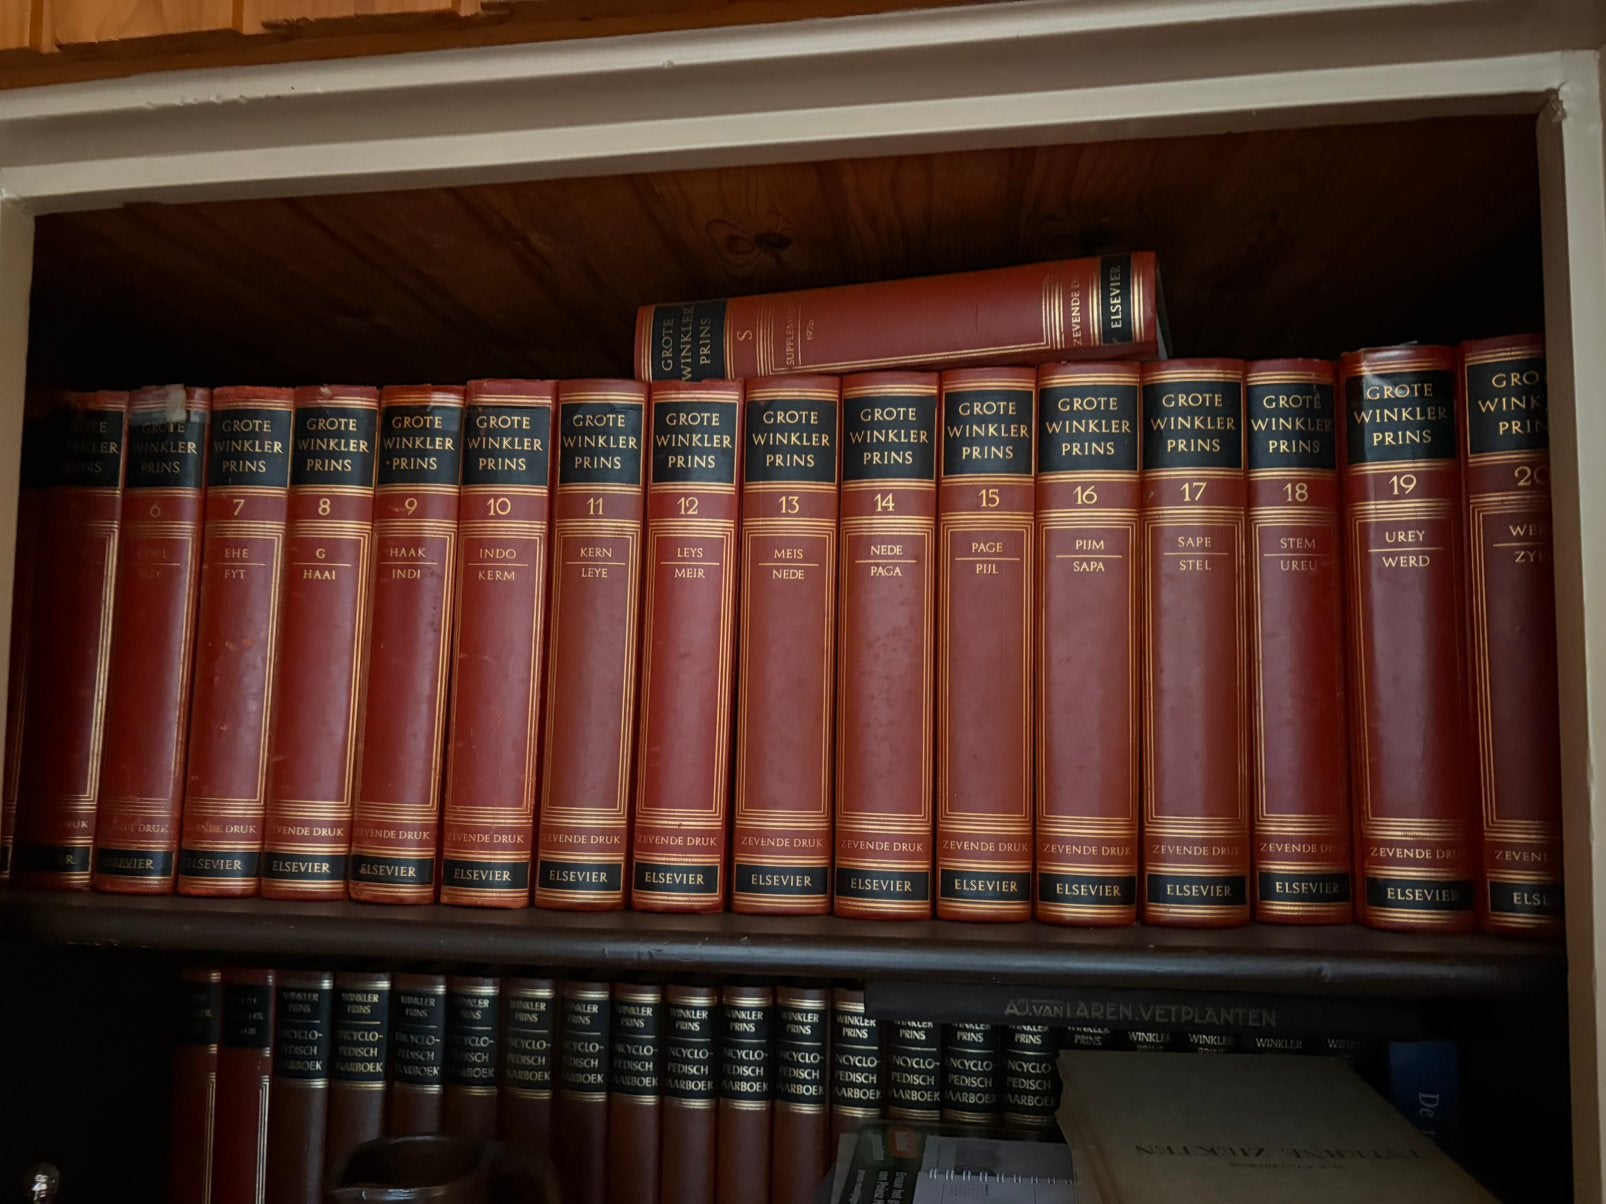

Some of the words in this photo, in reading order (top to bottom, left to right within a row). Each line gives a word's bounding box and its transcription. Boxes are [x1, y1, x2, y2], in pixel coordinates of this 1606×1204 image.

[1109, 265, 1122, 329] ELSEVIER
[1071, 290, 1082, 346] ZEVENDE
[680, 304, 694, 381] WINKLER
[699, 318, 711, 365] PRINS
[737, 330, 752, 342] S
[661, 318, 674, 372] GROTE
[1367, 383, 1433, 400] GROTE
[1058, 397, 1118, 412] GROTE
[1162, 393, 1223, 408] GROTE
[1263, 395, 1321, 410] GROTE
[860, 408, 917, 422] GROTE
[958, 402, 1017, 416] GROTE
[1353, 405, 1447, 424] WINKLER
[306, 418, 358, 431] GROTE
[391, 416, 442, 429] GROTE
[476, 416, 531, 429] GROTE
[572, 414, 625, 427] GROTE
[666, 413, 720, 427] GROTE
[763, 411, 818, 425] GROTE
[1150, 416, 1236, 431] WINKLER
[1251, 417, 1332, 432] WINKLER
[221, 419, 272, 433] GROTE
[947, 424, 1030, 439] WINKLER
[1046, 419, 1131, 435] WINKLER
[563, 435, 638, 449] WINKLER
[656, 434, 732, 448] WINKLER
[752, 432, 830, 447] WINKLER
[850, 430, 929, 444] WINKLER
[1373, 430, 1432, 446] PRINS
[133, 440, 198, 455] WINKLER
[213, 440, 283, 454] WINKLER
[298, 439, 370, 453] WINKLER
[383, 437, 455, 451] WINKLER
[467, 437, 543, 451] WINKLER
[1062, 442, 1115, 456] PRINS
[1167, 439, 1221, 453] PRINS
[1269, 440, 1321, 454] PRINS
[863, 451, 913, 465] PRINS
[962, 446, 1014, 460] PRINS
[221, 460, 267, 473] PRINS
[306, 459, 352, 472] PRINS
[392, 457, 437, 470] PRINS
[478, 458, 526, 471] PRINS
[575, 456, 621, 470] PRINS
[668, 455, 716, 468] PRINS
[766, 454, 815, 467] PRINS
[141, 461, 182, 475] PRINS
[1180, 482, 1207, 501] 17
[1389, 474, 1416, 496] 19
[978, 489, 1000, 507] 15
[1073, 485, 1098, 505] 16
[1283, 483, 1309, 502] 18
[232, 499, 246, 516] 7
[318, 498, 331, 516] 8
[404, 497, 418, 515] 9
[486, 498, 511, 516] 10
[587, 498, 604, 515] 11
[677, 497, 699, 514] 12
[779, 496, 799, 514] 13
[873, 493, 895, 512] 14
[150, 502, 161, 518] 6
[1178, 537, 1212, 548] SAPE
[1385, 530, 1425, 543] UREY
[972, 542, 1004, 553] PAGE
[1075, 539, 1105, 550] PIJM
[1280, 538, 1316, 549] STEM
[224, 548, 249, 558] EHE
[316, 548, 326, 559] G
[390, 548, 426, 558] HAAK
[479, 548, 516, 559] INDO
[580, 547, 612, 558] KERN
[677, 547, 703, 558] LEYS
[774, 549, 803, 559] MEIS
[870, 545, 903, 556] NEDE
[1073, 561, 1105, 572] SAPA
[1179, 560, 1212, 571] STEL
[1280, 560, 1318, 571] UREU
[1382, 555, 1430, 568] WERD
[224, 570, 247, 580] FYT
[303, 570, 336, 580] HAAI
[392, 569, 421, 580] INDI
[581, 568, 608, 579] LEYE
[674, 568, 706, 579] MEIR
[772, 569, 805, 580] NEDE
[870, 566, 902, 576] PAGA
[976, 563, 999, 574] PIJL
[478, 570, 515, 581] KERM
[225, 824, 257, 834] DRUK
[313, 827, 345, 837] DRUK
[398, 830, 430, 840] DRUK
[448, 833, 491, 844] ZEVENDE
[493, 834, 524, 844] DRUK
[542, 833, 588, 844] ZEVENDE
[590, 834, 621, 845] DRUK
[637, 836, 684, 847] ZEVENDE
[686, 837, 717, 847] DRUK
[740, 836, 791, 847] ZEVENDE
[793, 838, 823, 848] DRUK
[840, 840, 890, 851] ZEVENDE
[893, 842, 923, 852] DRUK
[942, 840, 995, 851] ZEVENDE
[998, 842, 1028, 852] DRUK
[1043, 844, 1098, 856] ZEVENDE
[1101, 846, 1132, 856] DRUK
[1152, 844, 1209, 856] ZEVENDE
[1212, 846, 1241, 857] DRUK
[1260, 842, 1317, 854] ZEVENDE
[1370, 846, 1432, 860] ZEVENDE
[272, 861, 331, 873] ELSEVIER
[360, 864, 417, 877] ELSEVIER
[454, 868, 512, 882] ELSEVIER
[549, 869, 608, 883] ELSEVIER
[645, 871, 705, 885] ELSEVIER
[751, 874, 812, 887] ELSEVIER
[850, 878, 912, 892] ELSEVIER
[955, 879, 1018, 893] ELSEVIER
[1056, 883, 1121, 897] ELSEVIER
[1167, 884, 1232, 897] ELSEVIER
[1275, 882, 1341, 895] ELSEVIER
[1387, 887, 1459, 902] ELSEVIER
[669, 1007, 709, 1020] WINKLER
[725, 1010, 764, 1020] WINKLER
[675, 1020, 700, 1031] PRINS
[836, 1014, 877, 1027] WINKLER
[729, 1022, 755, 1033] PRINS
[842, 1027, 869, 1039] PRINS
[899, 1029, 926, 1041] PRINS
[957, 1031, 984, 1043] PRINS
[1014, 1033, 1043, 1045] PRINS
[1418, 1091, 1440, 1119] De
